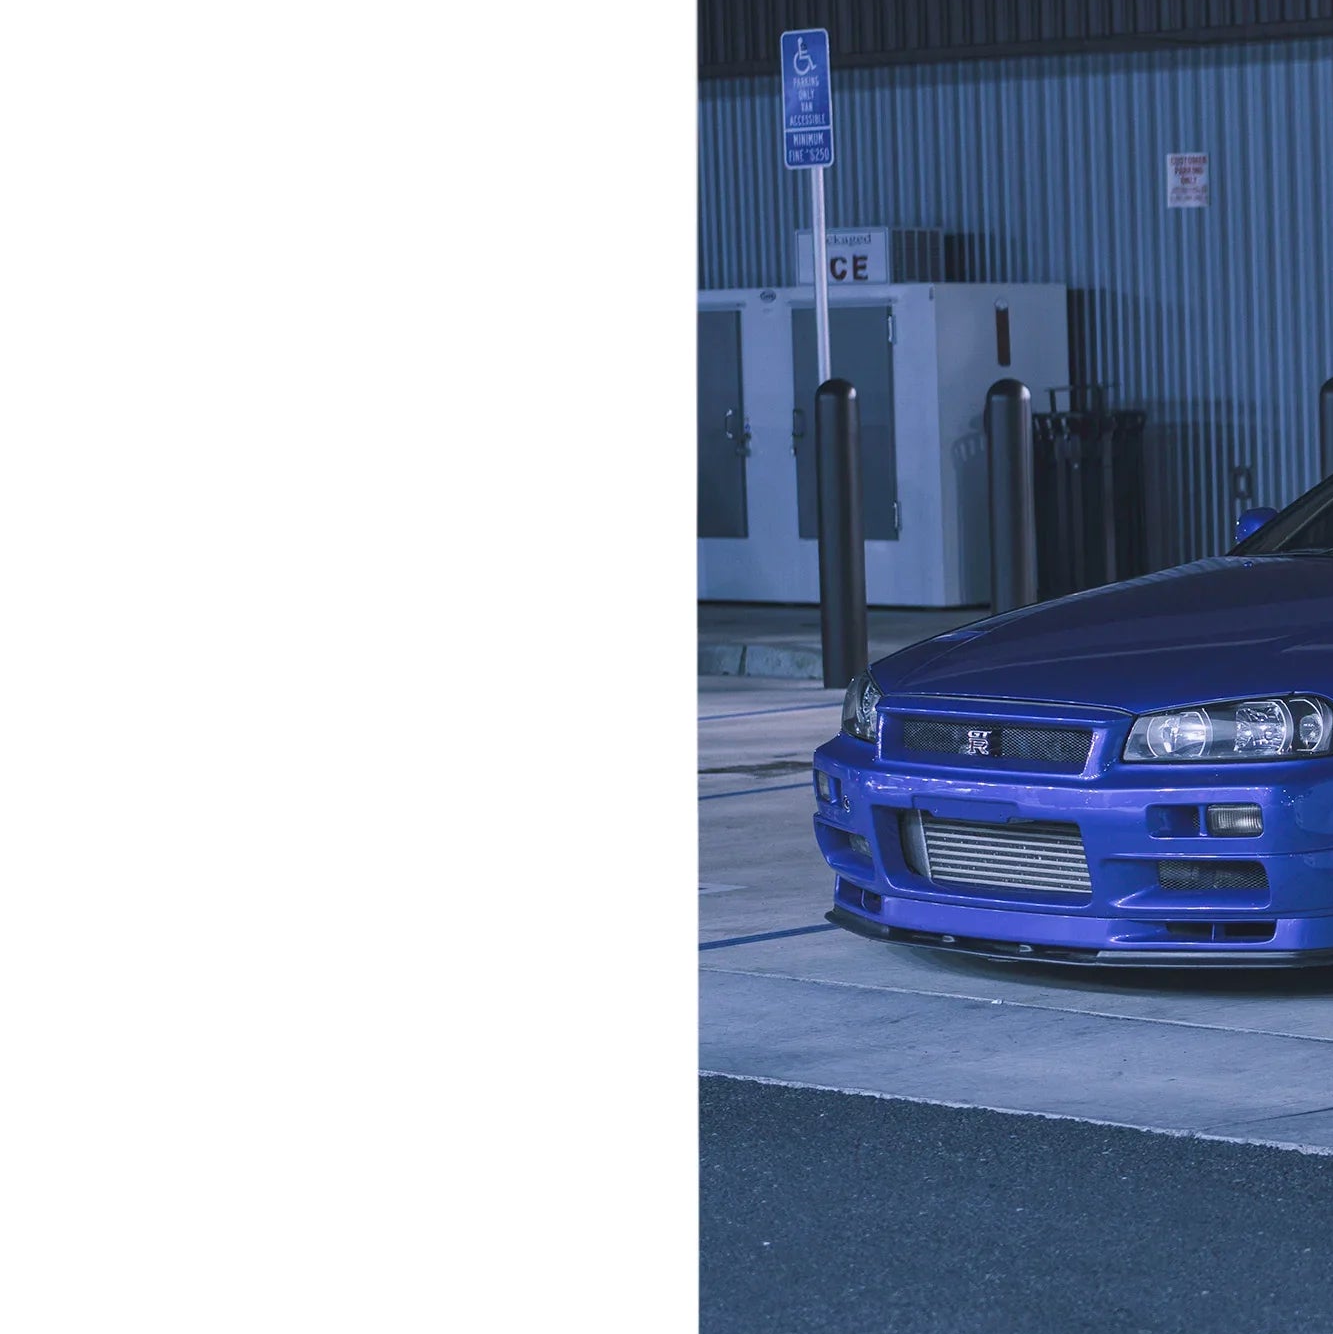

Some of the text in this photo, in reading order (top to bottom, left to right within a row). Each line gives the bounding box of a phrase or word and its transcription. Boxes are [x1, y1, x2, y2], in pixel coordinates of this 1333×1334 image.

[792, 75, 820, 88] PARKING
[797, 88, 815, 101] ONLY
[800, 101, 814, 113] VAN
[789, 113, 826, 127] ACCESSIBLE
[792, 132, 825, 147] MINIMUM
[788, 147, 830, 163] FINE $250
[826, 233, 872, 246] ckaged
[829, 253, 869, 282] CE
